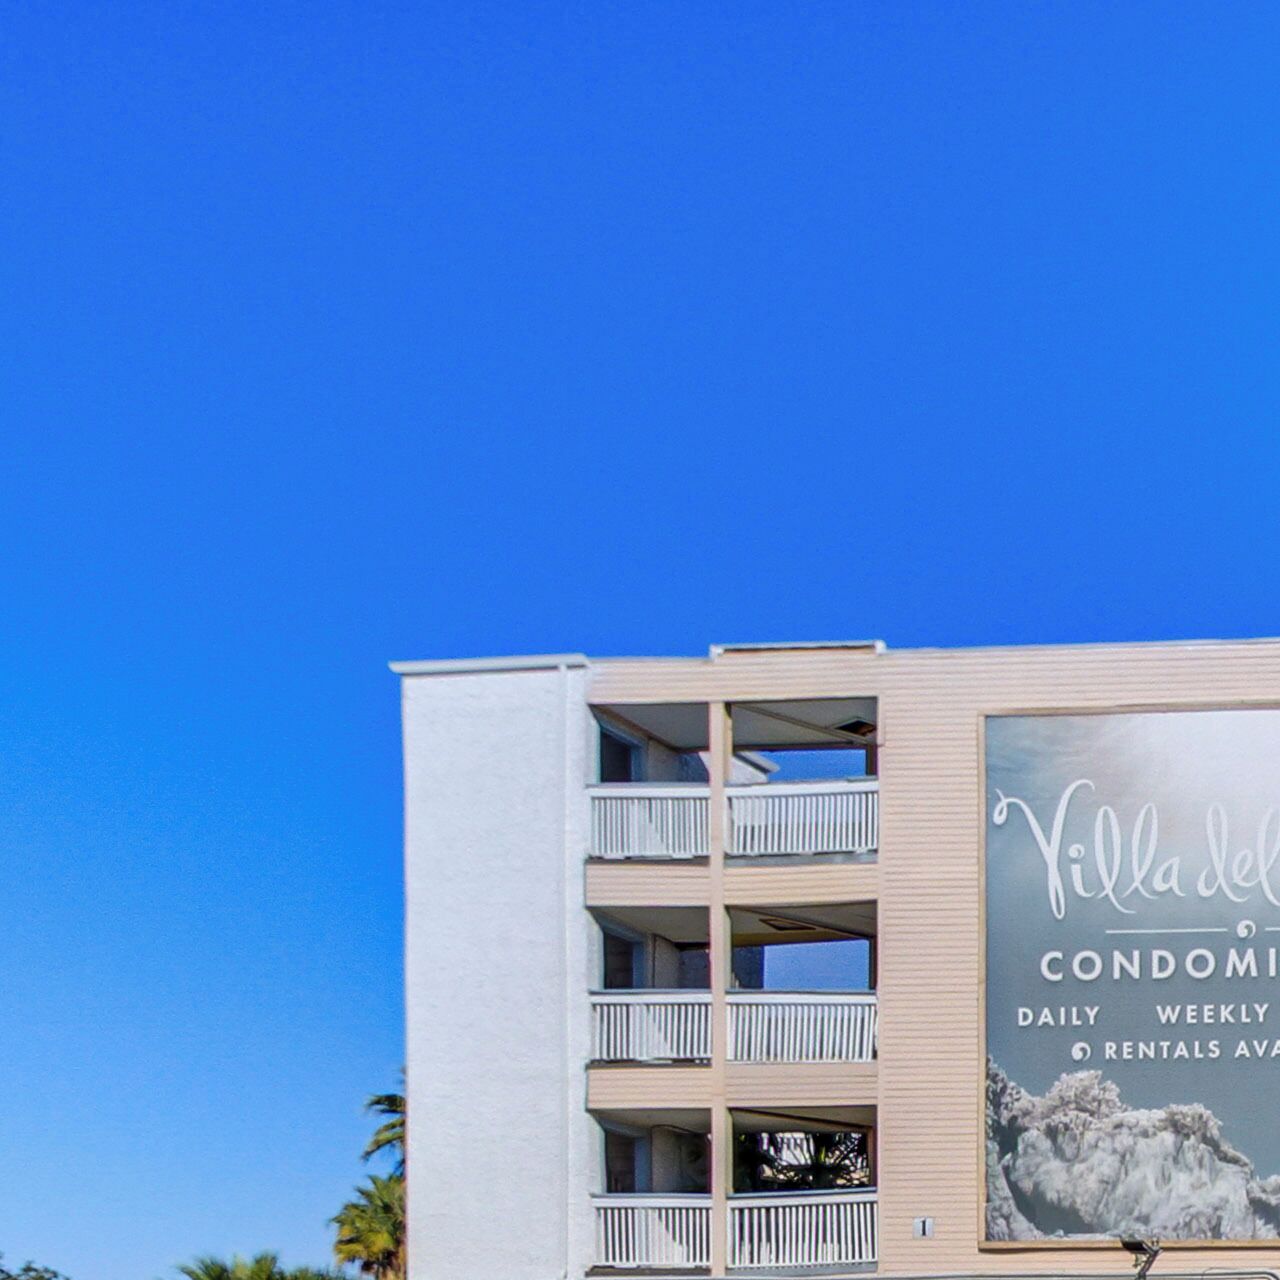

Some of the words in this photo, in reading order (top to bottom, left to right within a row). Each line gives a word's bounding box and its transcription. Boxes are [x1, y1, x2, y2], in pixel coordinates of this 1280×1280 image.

[993, 779, 1186, 920] Villa
[1017, 1006, 1100, 1026] DAILY
[1156, 1003, 1269, 1024] WEEKLY
[1104, 1040, 1220, 1060] RENTALS
